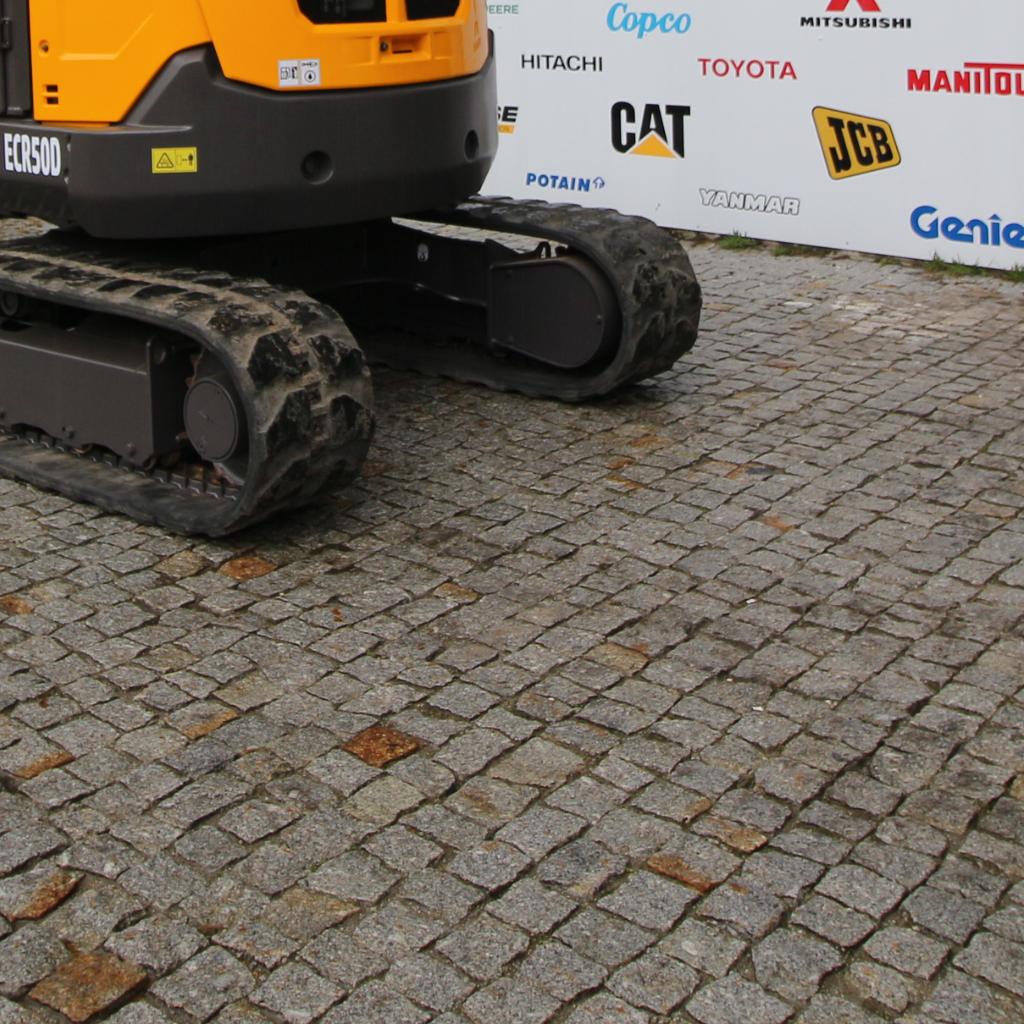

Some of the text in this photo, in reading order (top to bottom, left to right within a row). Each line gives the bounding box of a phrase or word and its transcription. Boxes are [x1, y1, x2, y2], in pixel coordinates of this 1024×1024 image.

[486, 4, 520, 15] EERE
[606, 2, 692, 39] Copco
[800, 16, 912, 29] MITSUBISHI
[521, 54, 603, 72] HITACHI
[697, 58, 798, 80] TOYOTA
[611, 101, 691, 159] CAT
[4, 132, 62, 177] ECR50D
[826, 115, 894, 174] JCB
[526, 172, 591, 193] POTAIN
[699, 188, 801, 216] YANMAR
[910, 205, 1024, 250] Genie
